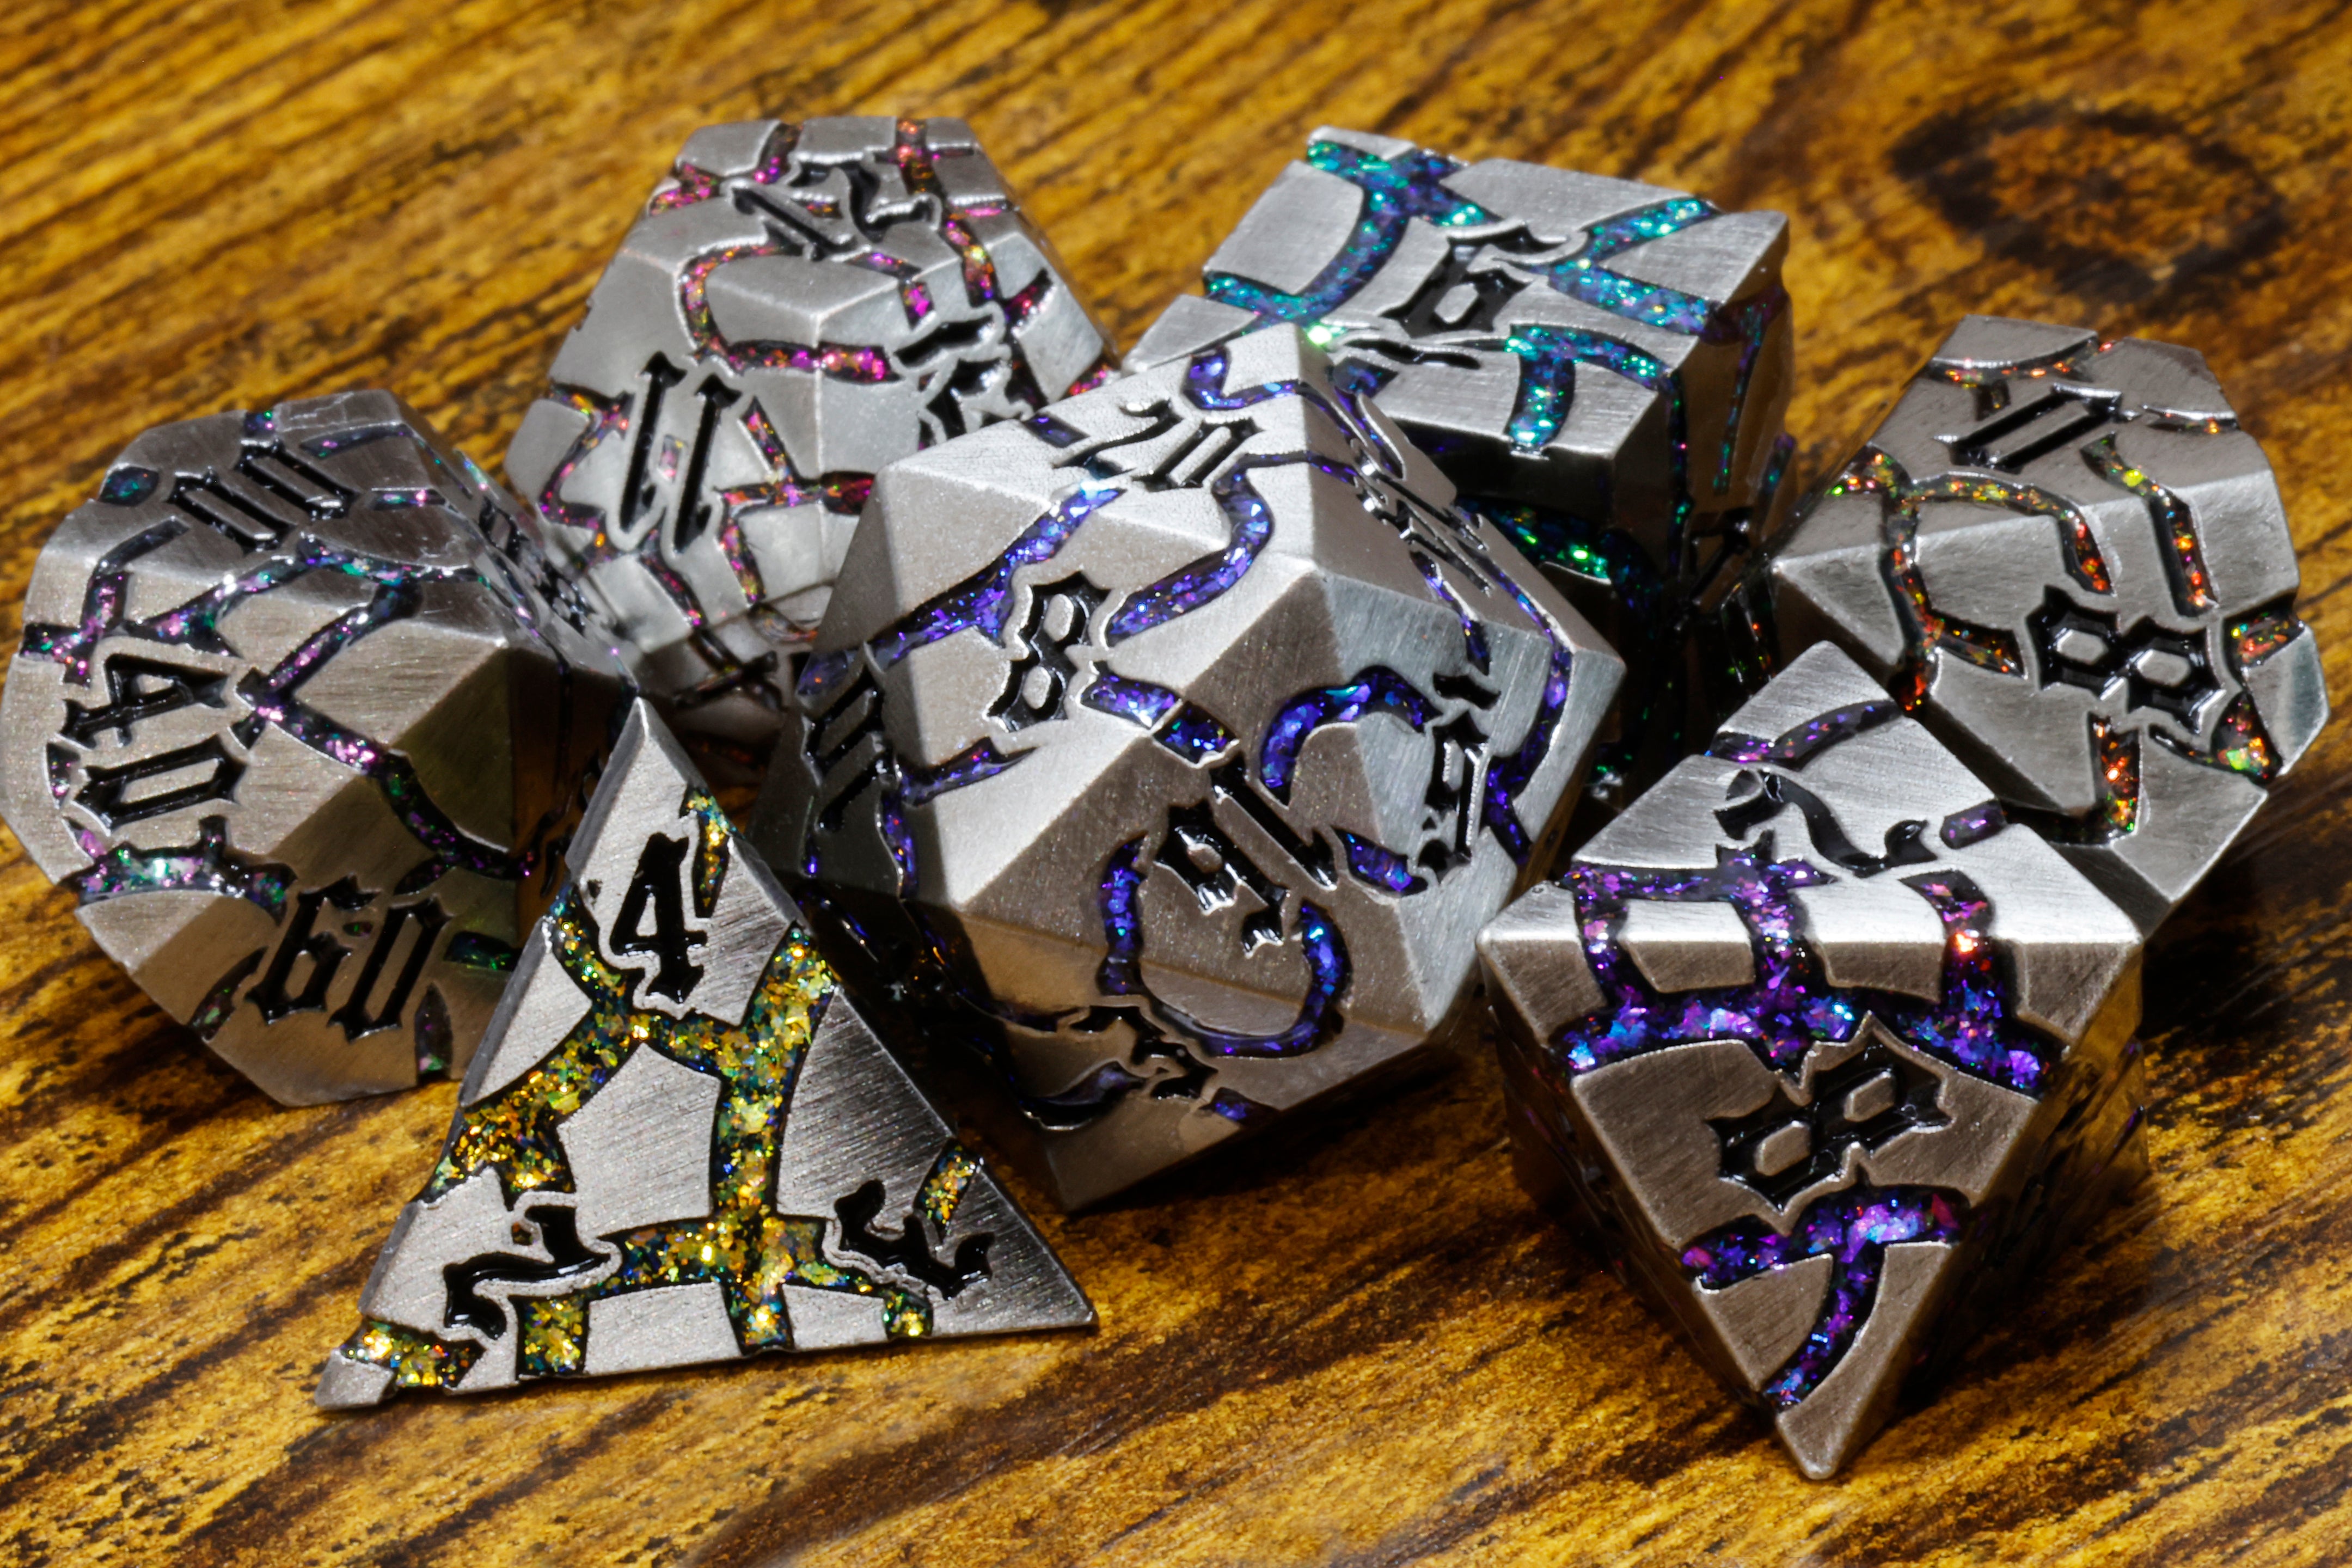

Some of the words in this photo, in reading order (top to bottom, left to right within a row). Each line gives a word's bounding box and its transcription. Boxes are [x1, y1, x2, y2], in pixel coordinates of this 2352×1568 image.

[730, 154, 938, 260] 12
[166, 438, 358, 551] 00
[615, 353, 742, 552] 11
[1053, 399, 1264, 493] 20
[987, 569, 1111, 733] 8
[2026, 584, 2225, 734] 8
[56, 652, 245, 837] 40
[1715, 767, 1936, 872] 2
[609, 832, 708, 1002] 4
[1138, 754, 1337, 960] 16
[244, 875, 454, 1043] 60
[1704, 1034, 1952, 1214] 8
[443, 1203, 610, 1340] 2
[834, 1178, 994, 1300] 3
